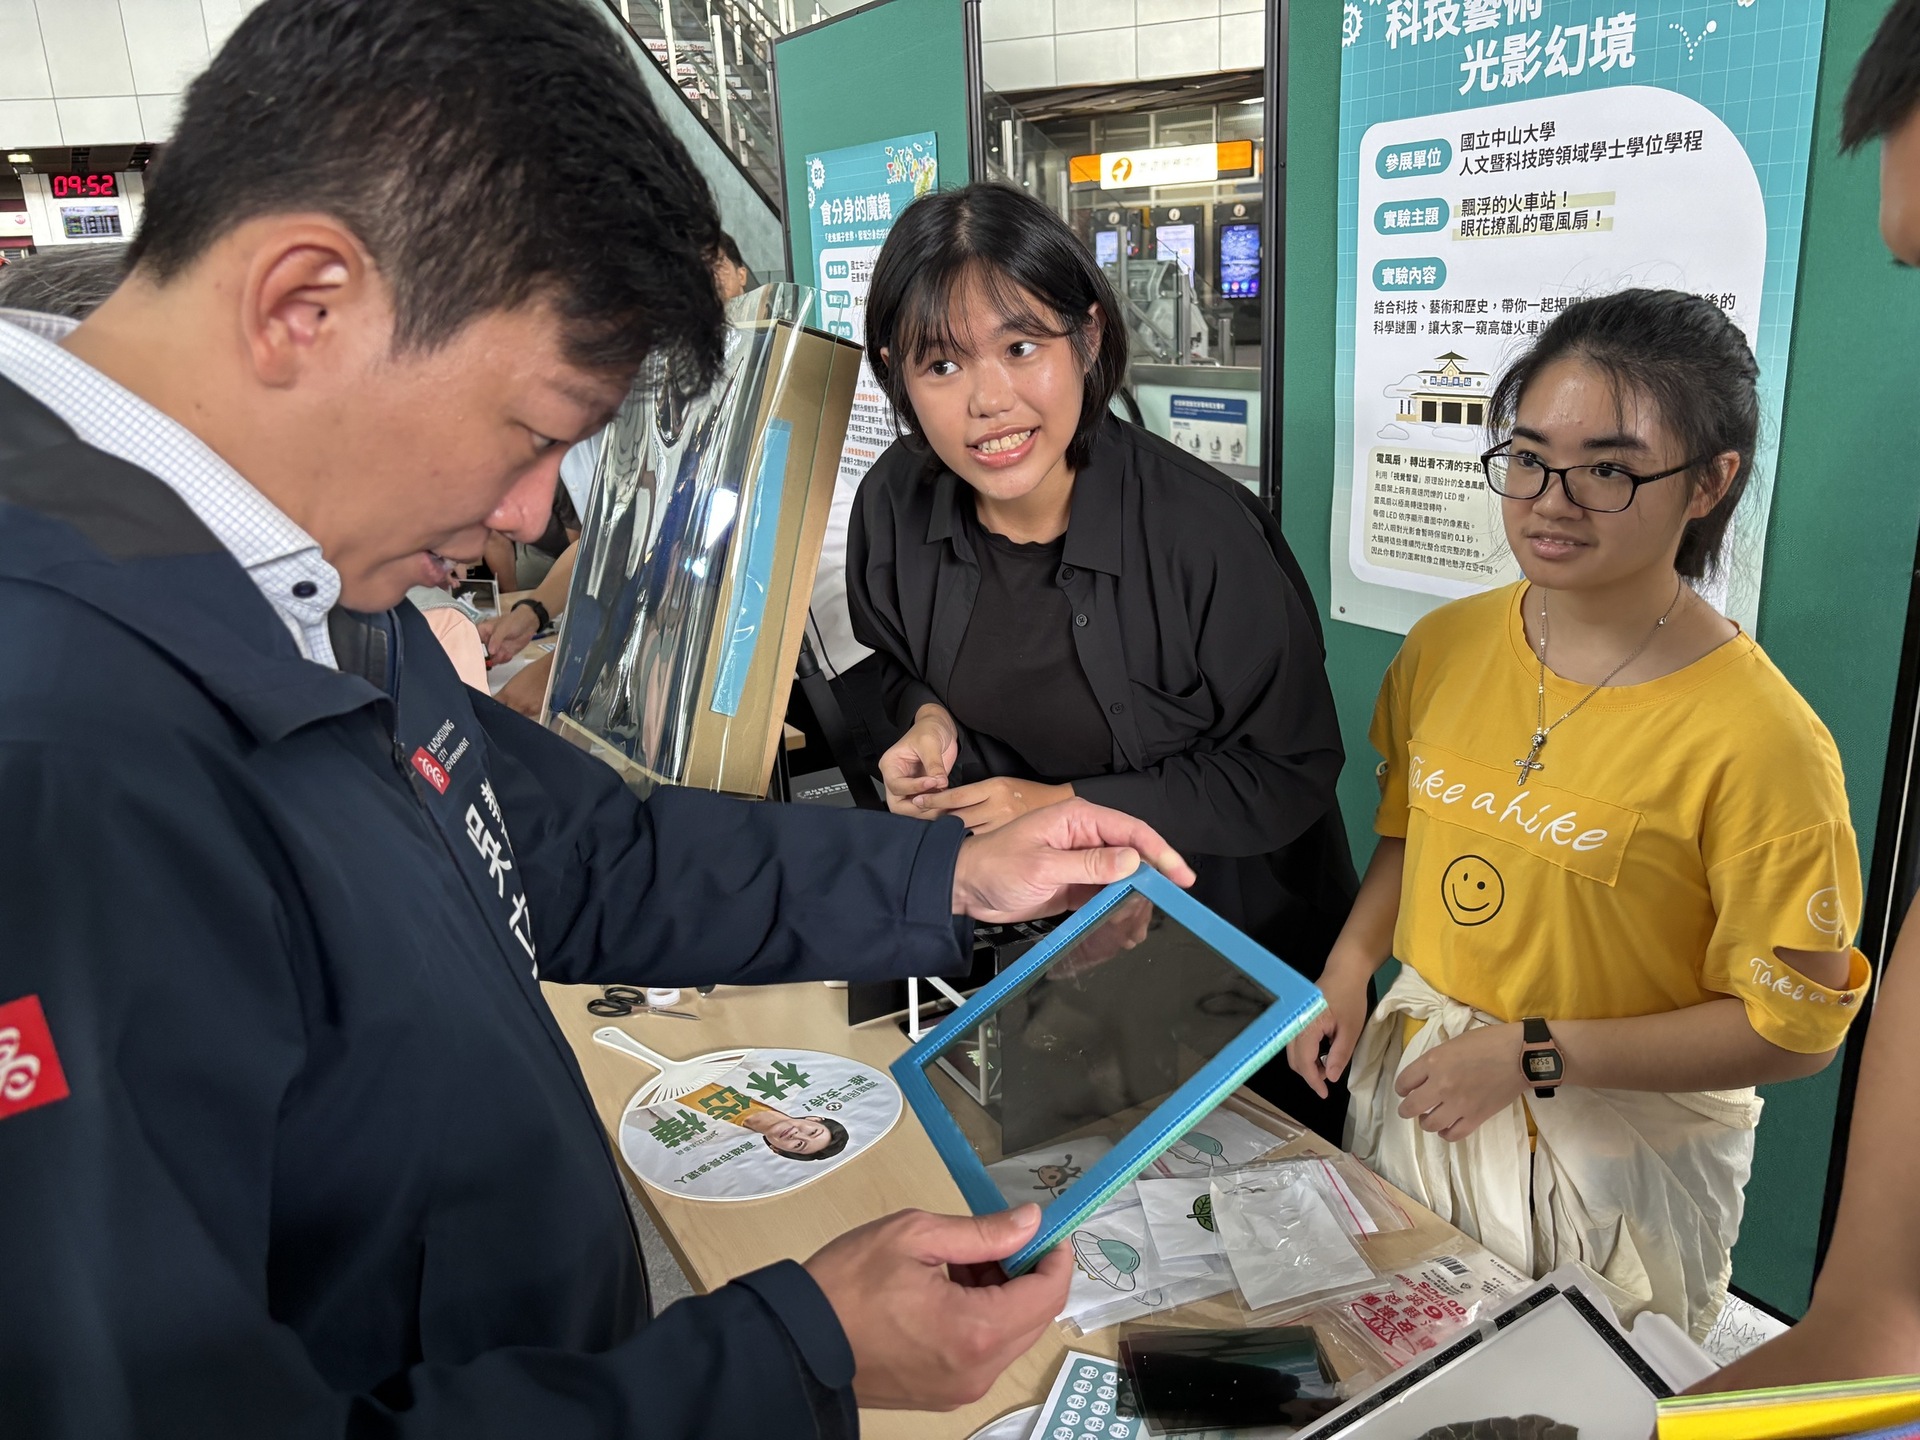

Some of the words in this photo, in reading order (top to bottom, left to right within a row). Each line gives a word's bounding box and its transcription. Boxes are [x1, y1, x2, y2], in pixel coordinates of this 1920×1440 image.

[1459, 11, 1637, 96] 光影幻境
[1460, 121, 1556, 152] 國立中山大學
[1385, 147, 1442, 173] 參展單位
[1459, 130, 1703, 176] 人文暨科技跨領域學士學位學程
[54, 175, 114, 196] 09:52
[820, 192, 892, 226] 會分身的魔鏡
[1383, 206, 1440, 228] 實驗主題
[1460, 210, 1602, 238] 眼花撩亂的電風扇！
[1381, 265, 1437, 286] 實驗內容
[1376, 453, 1485, 475] 電風扇，轉出看不清的字和
[1443, 492, 1458, 501] LED
[1385, 511, 1398, 520] LED
[1454, 533, 1466, 543] 0.1
[427, 719, 455, 754] KAOHSIUNG
[437, 747, 449, 763] CITY
[444, 737, 470, 773] GOVERNMENT
[1409, 755, 1467, 804] Take
[1750, 957, 1804, 1001] Take
[648, 1060, 812, 1149] 林岱樺
[674, 1140, 757, 1185] 高雄市長參選人
[1418, 1281, 1449, 1301] PCS
[1423, 1304, 1444, 1320] 6
